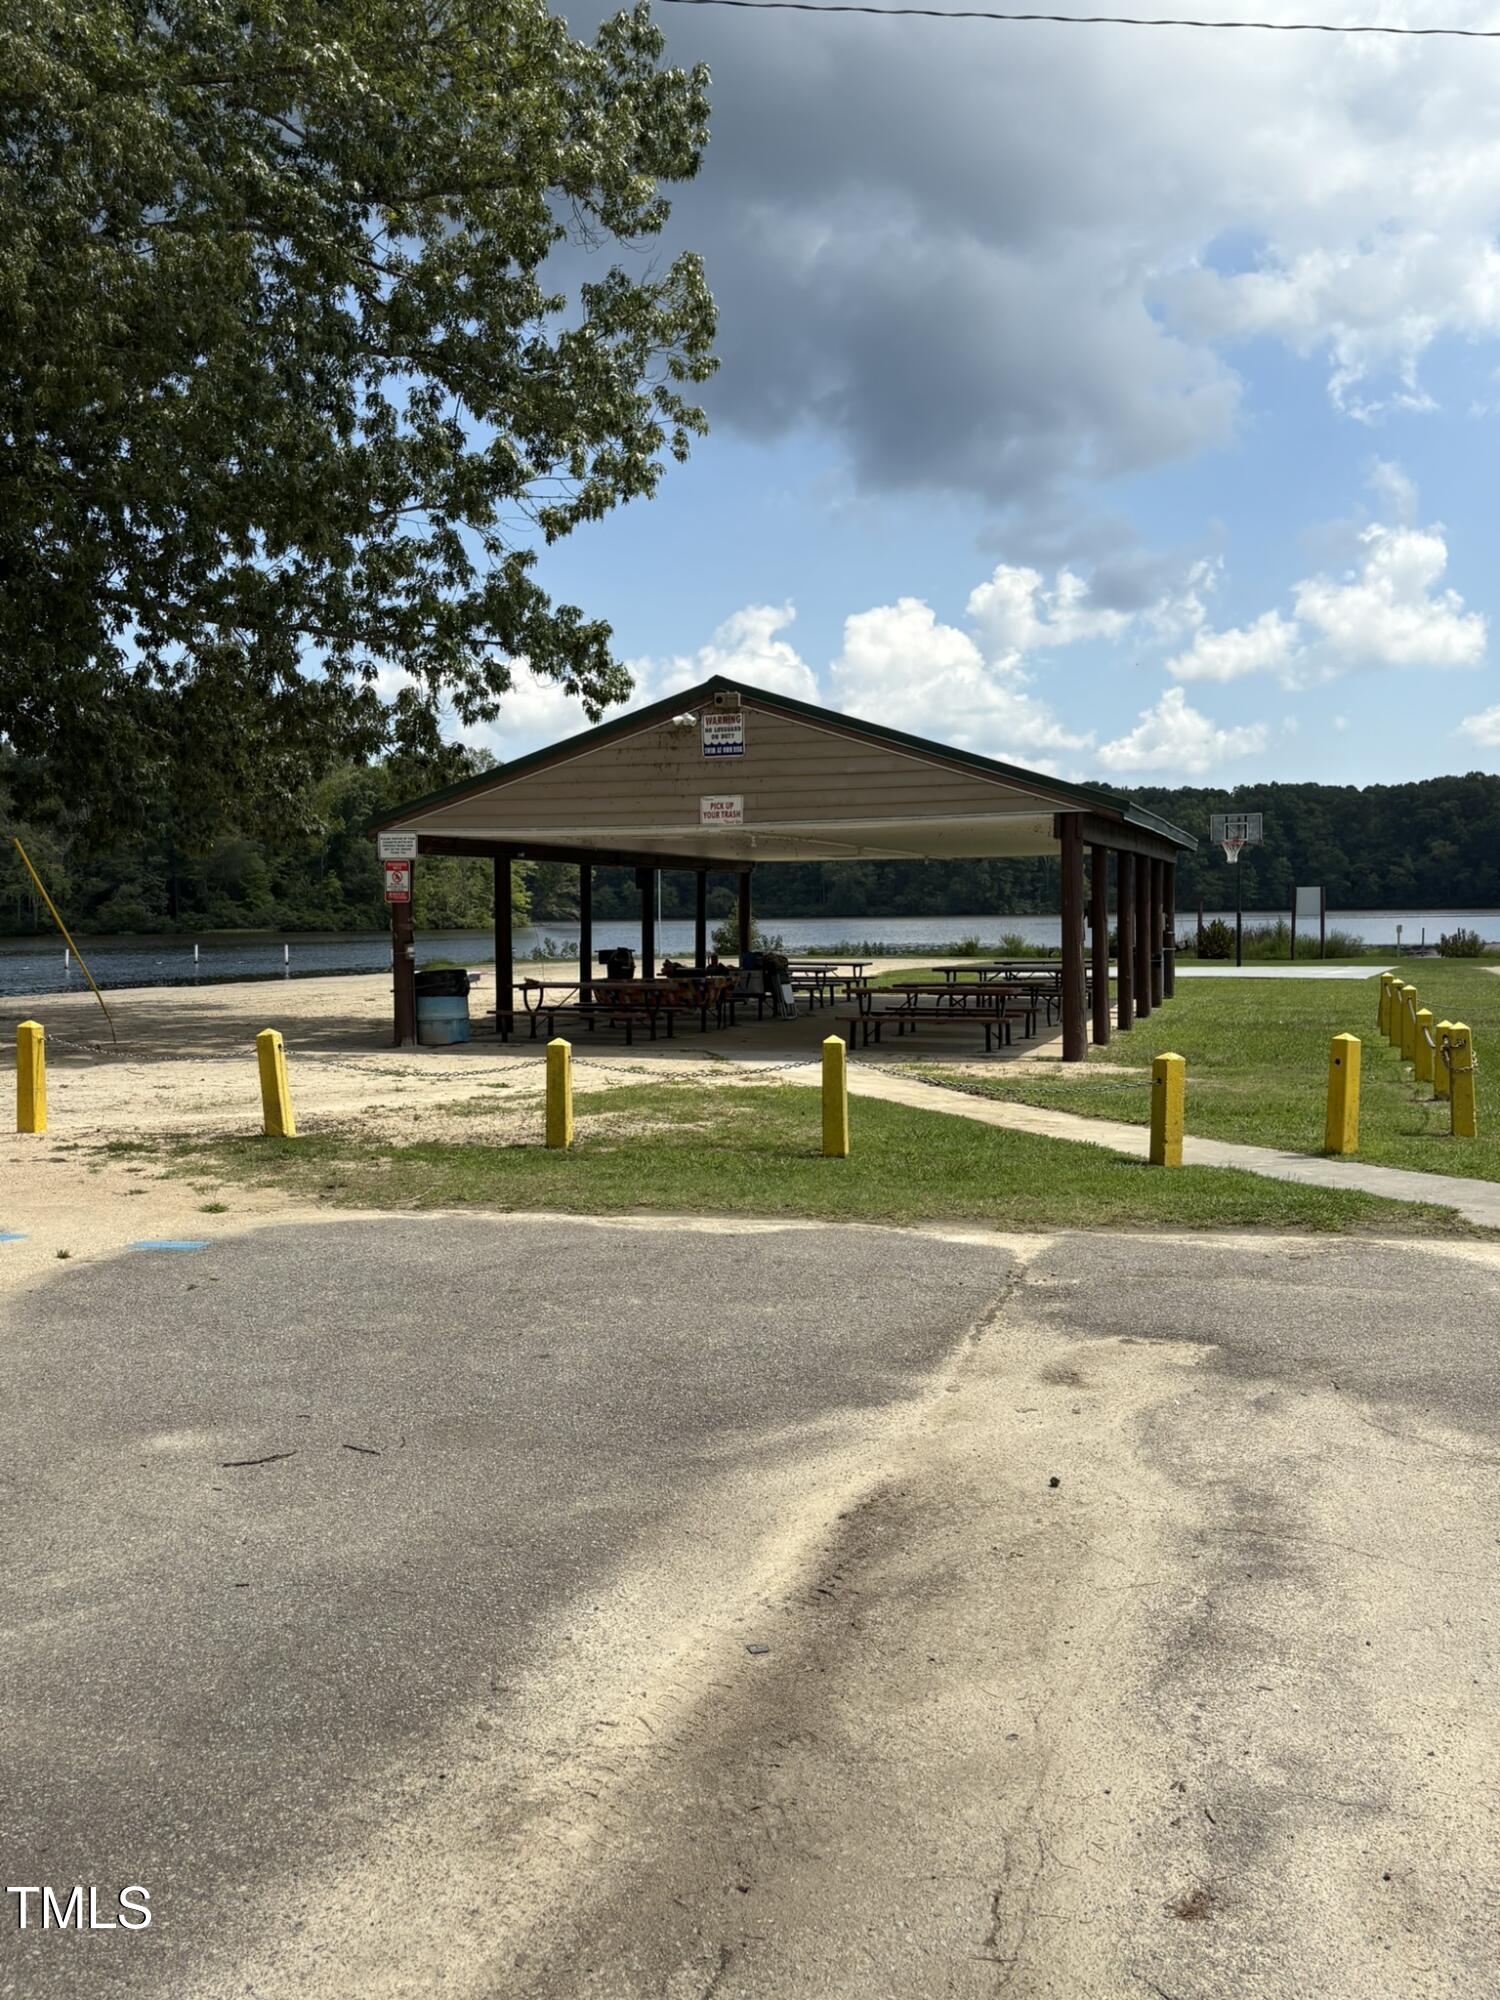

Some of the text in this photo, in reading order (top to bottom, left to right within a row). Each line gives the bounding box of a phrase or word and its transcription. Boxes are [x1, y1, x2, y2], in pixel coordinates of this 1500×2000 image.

[705, 714, 742, 725] WARNING
[710, 801, 734, 810] PICK UP
[703, 810, 741, 819] YOUR TRASH
